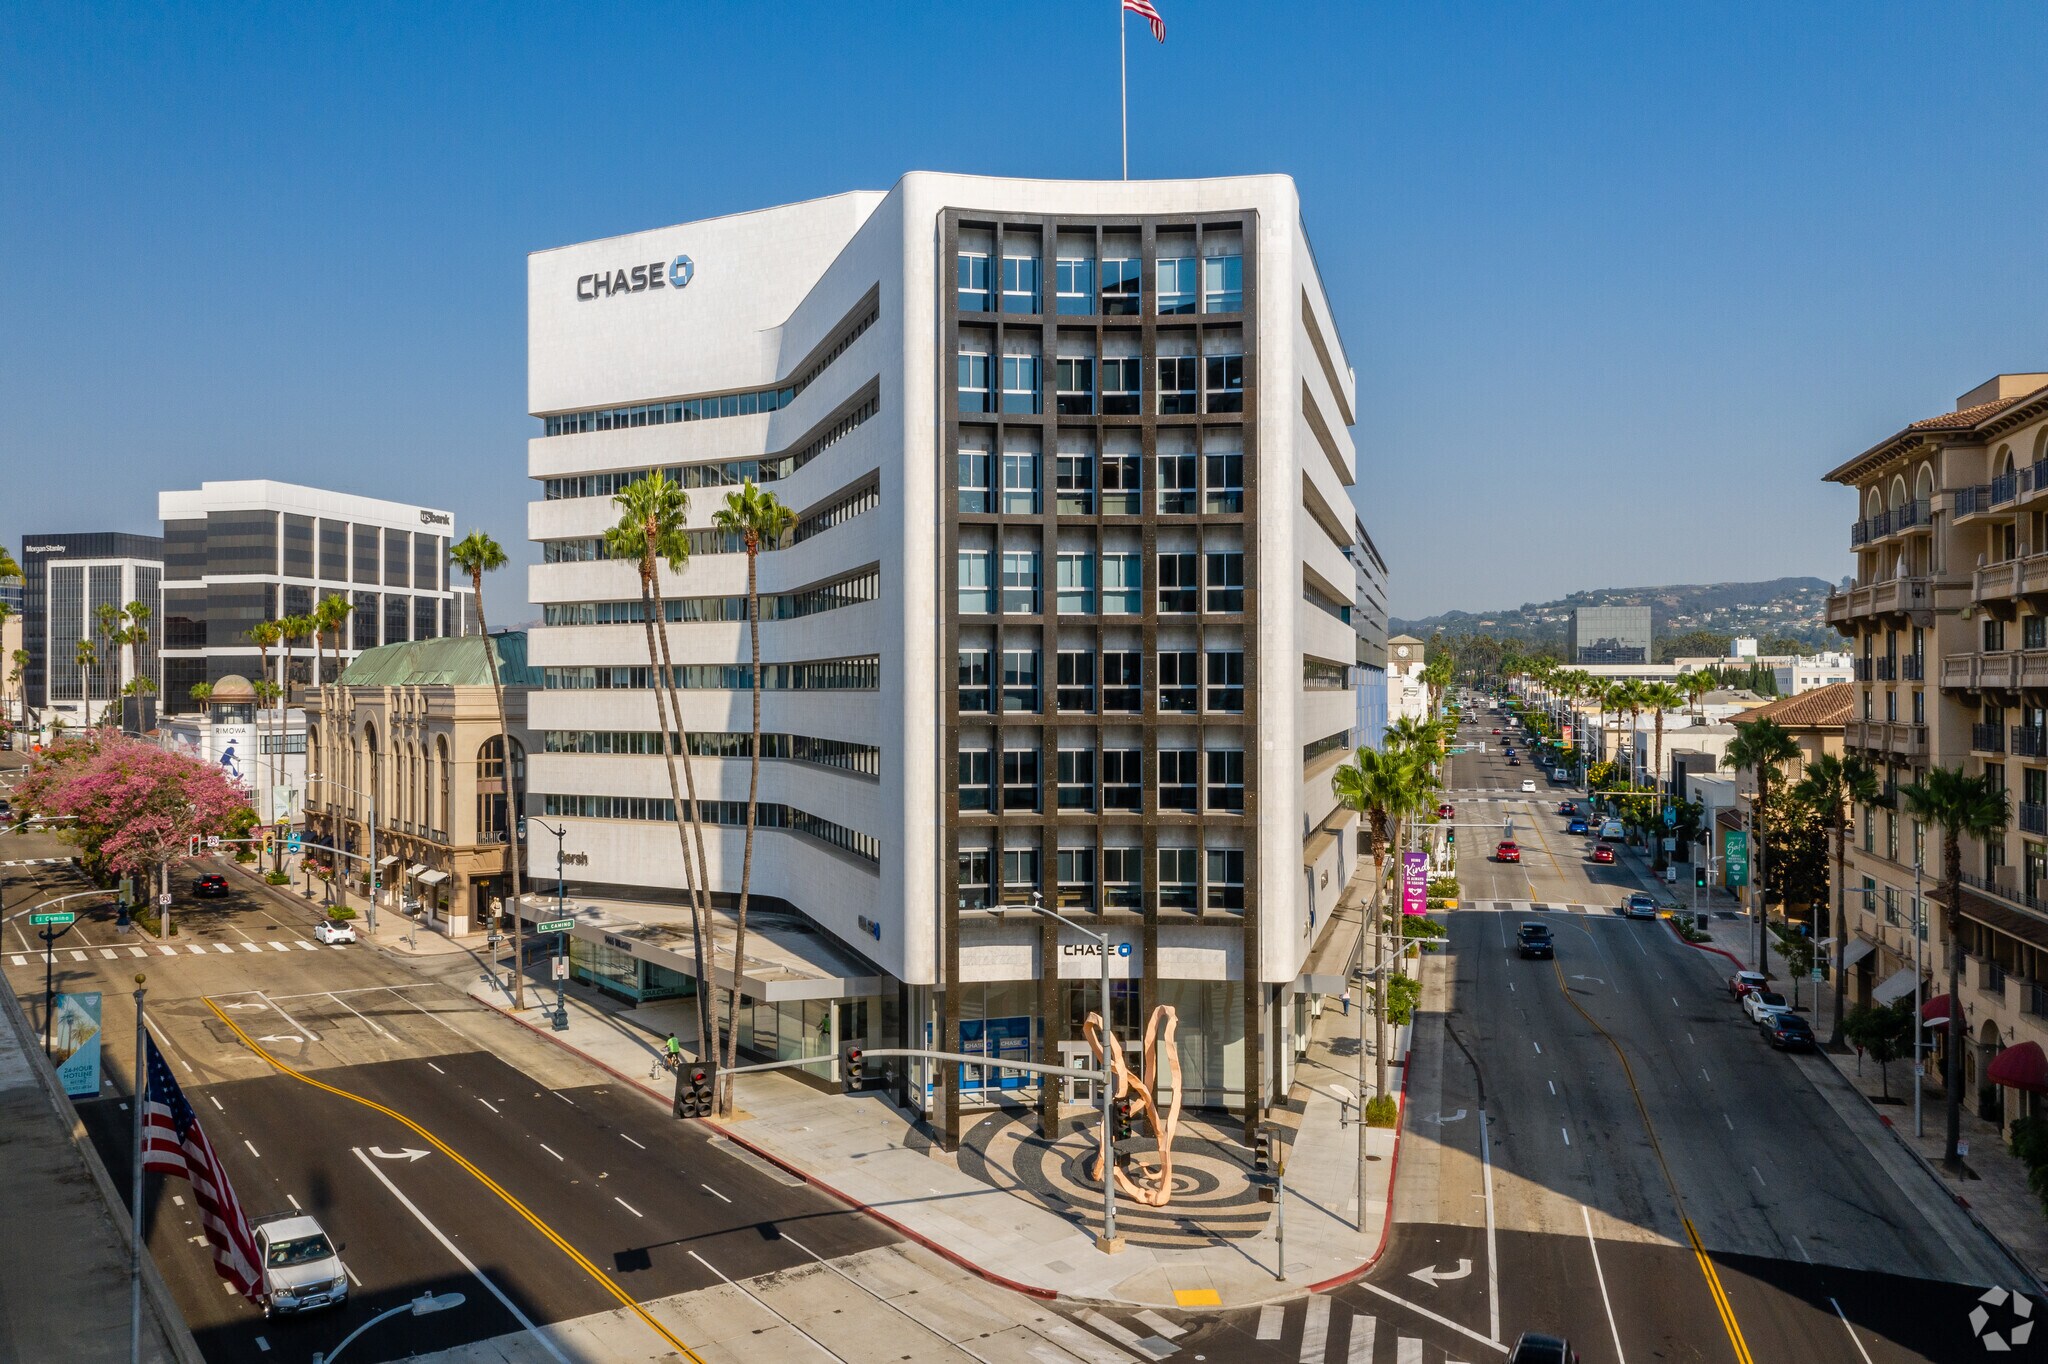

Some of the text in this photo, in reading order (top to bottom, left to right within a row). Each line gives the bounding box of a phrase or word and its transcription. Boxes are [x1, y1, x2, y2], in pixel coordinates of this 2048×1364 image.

[577, 262, 666, 300] CHASE
[215, 727, 247, 735] RIMOWA
[1404, 853, 1430, 876] Kind
[1064, 945, 1116, 956] CHASE
[641, 987, 676, 997] SOULCYCLE
[1000, 1039, 1021, 1047] CHASE
[64, 1065, 93, 1074] 24-HOUR
[63, 1071, 93, 1079] HOTLINE
